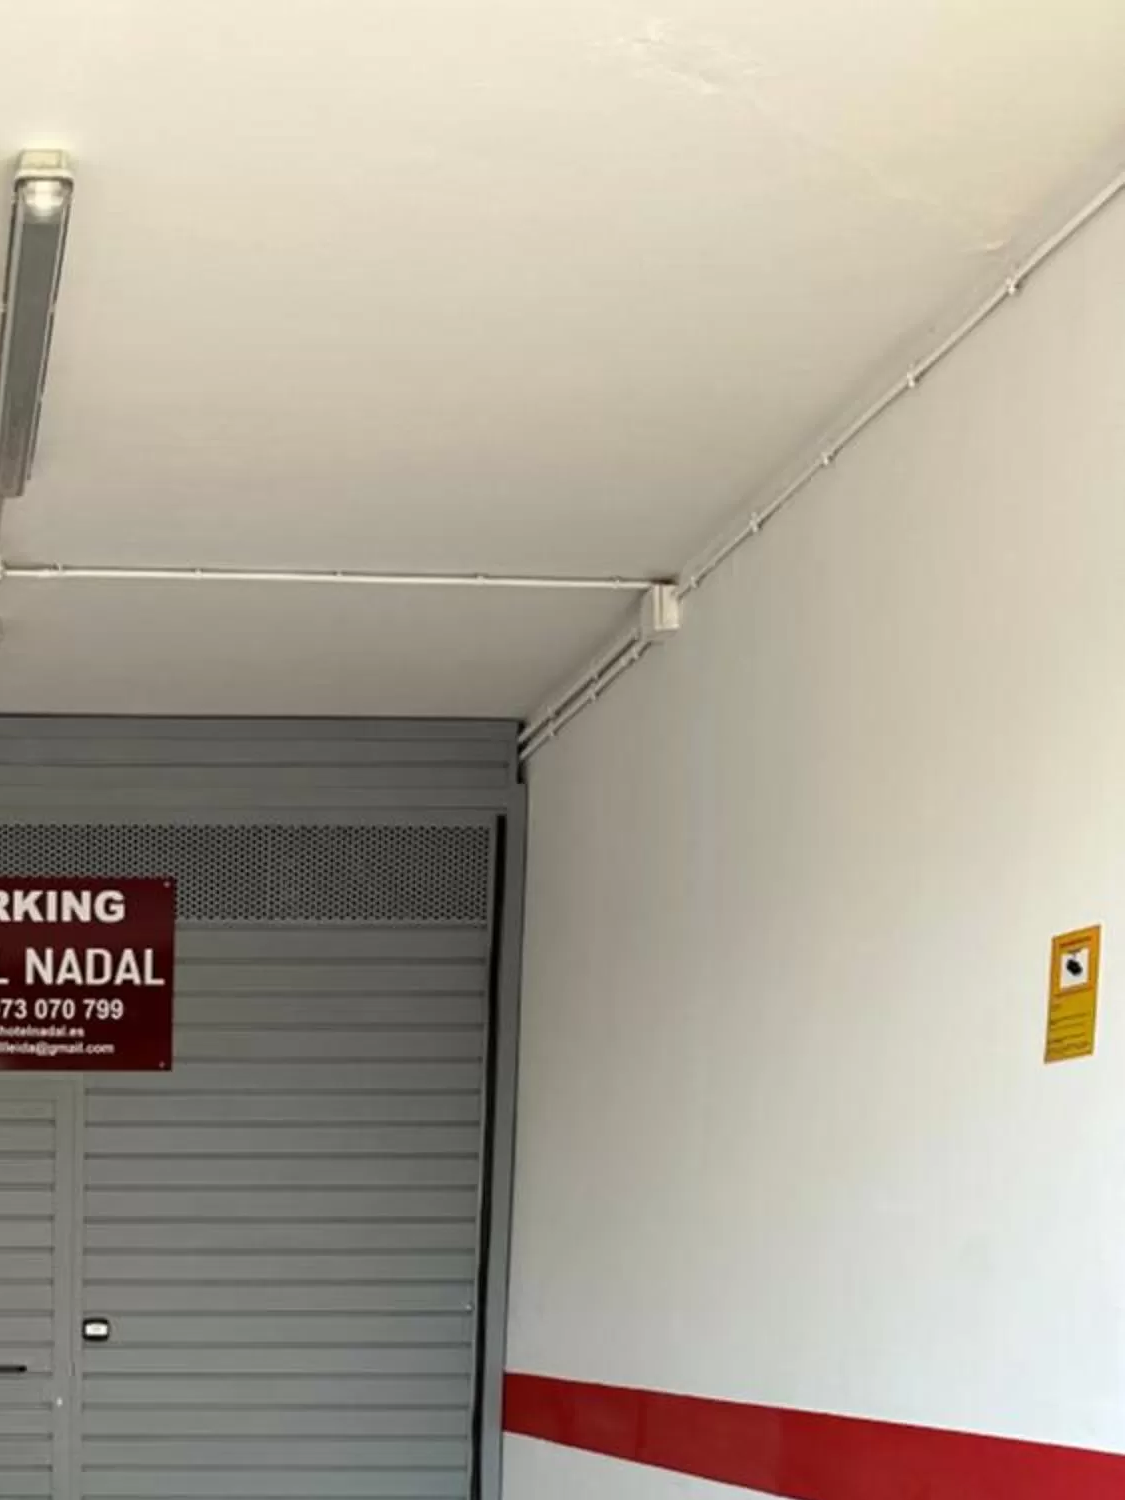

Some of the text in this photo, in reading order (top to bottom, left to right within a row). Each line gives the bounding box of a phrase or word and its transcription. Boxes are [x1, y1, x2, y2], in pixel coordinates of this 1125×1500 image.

[25, 947, 165, 986] NADAL
[34, 998, 76, 1020] 070
[82, 998, 124, 1020] 799
